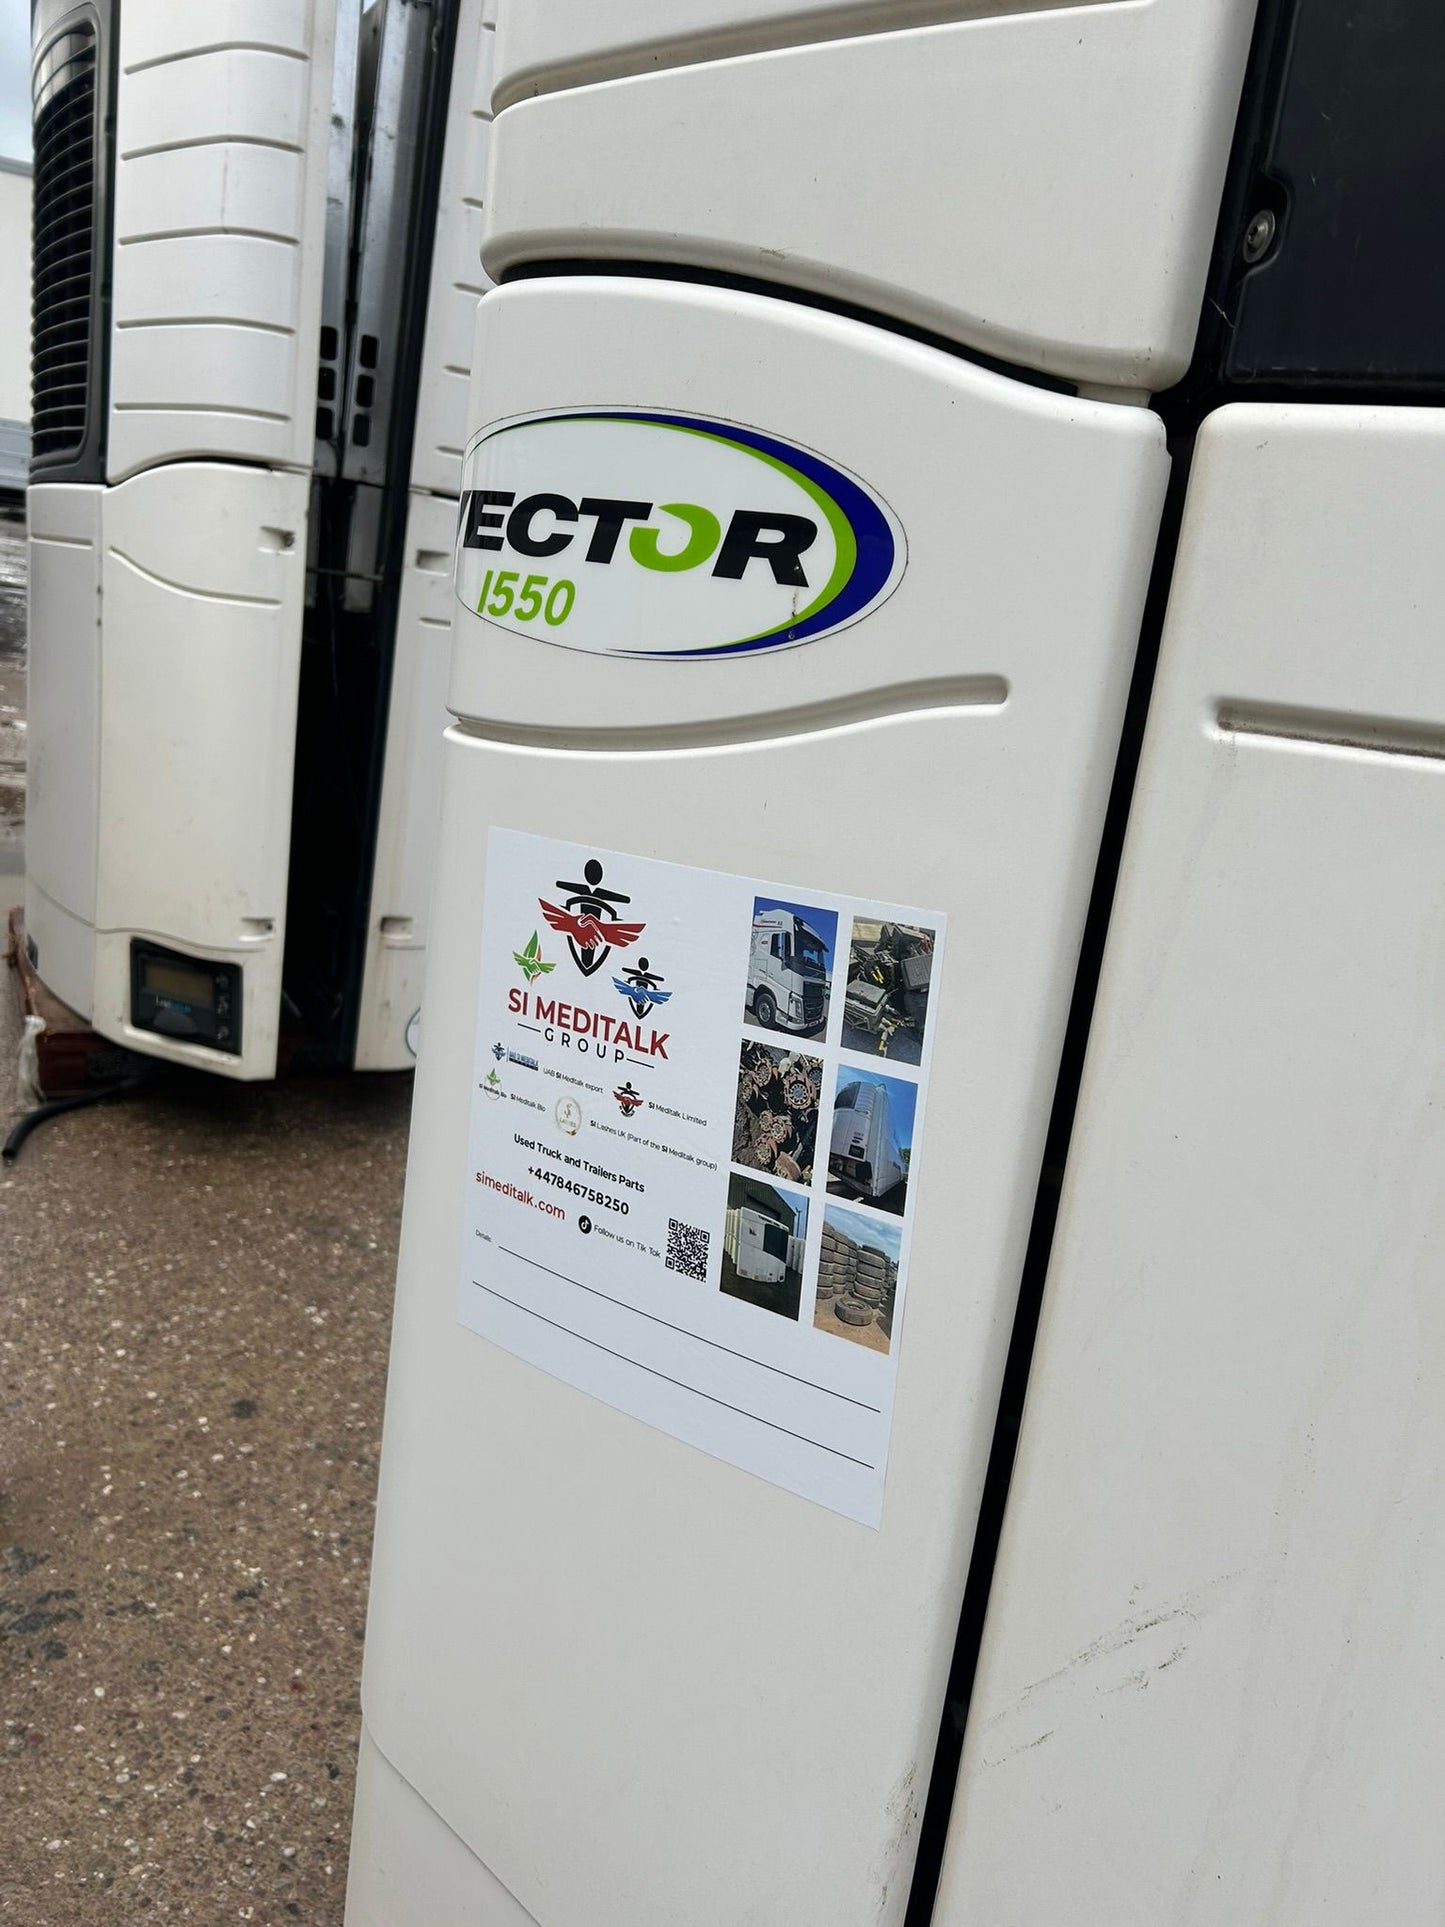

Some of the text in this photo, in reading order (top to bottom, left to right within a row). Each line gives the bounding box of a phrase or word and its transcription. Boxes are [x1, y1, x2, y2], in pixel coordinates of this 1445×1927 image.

[477, 570, 576, 626] 1550
[508, 988, 670, 1059] SI MEDITALK
[545, 1028, 625, 1063] GROUP
[648, 1101, 707, 1126] SI Meditalk Limited
[514, 1133, 645, 1193] Used Truck and Trailers Parts
[643, 1138, 650, 1146] of
[650, 1140, 660, 1150] the
[661, 1145, 668, 1153] SI
[668, 1147, 695, 1162] Meditalk
[696, 1157, 718, 1171] group)
[476, 1170, 565, 1220] simeditalk.com
[528, 1166, 629, 1215] +447846758250
[594, 1224, 615, 1240] Follow
[615, 1235, 625, 1243] us
[625, 1239, 634, 1248] on
